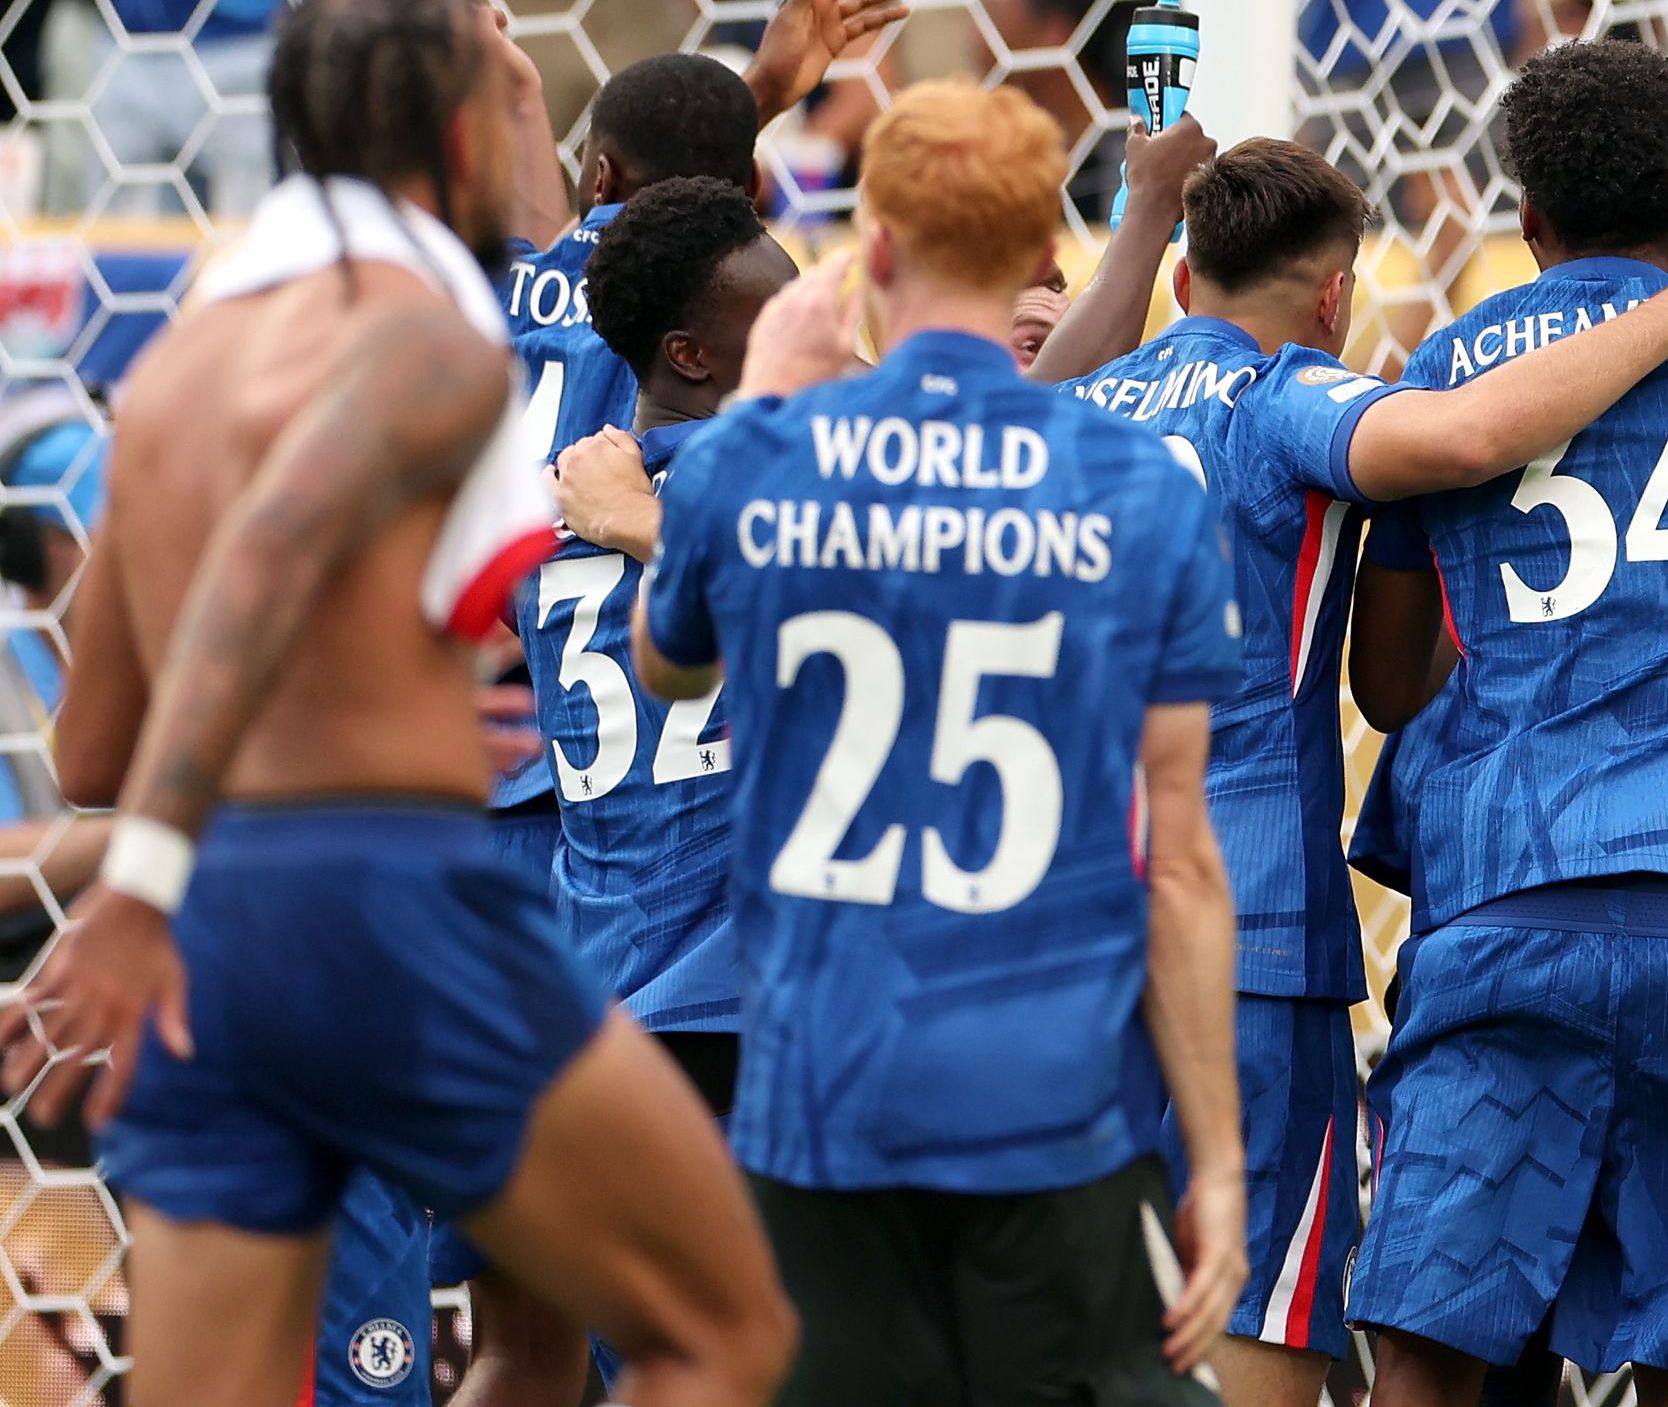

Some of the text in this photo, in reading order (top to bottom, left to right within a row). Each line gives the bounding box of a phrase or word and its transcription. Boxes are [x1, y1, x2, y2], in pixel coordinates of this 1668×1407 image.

[509, 259, 594, 328] TOS
[1072, 359, 1258, 424] NSELMINO
[811, 414, 1049, 492] WORLD
[737, 497, 1112, 584] CHAMPIONS
[769, 608, 1065, 916] 25
